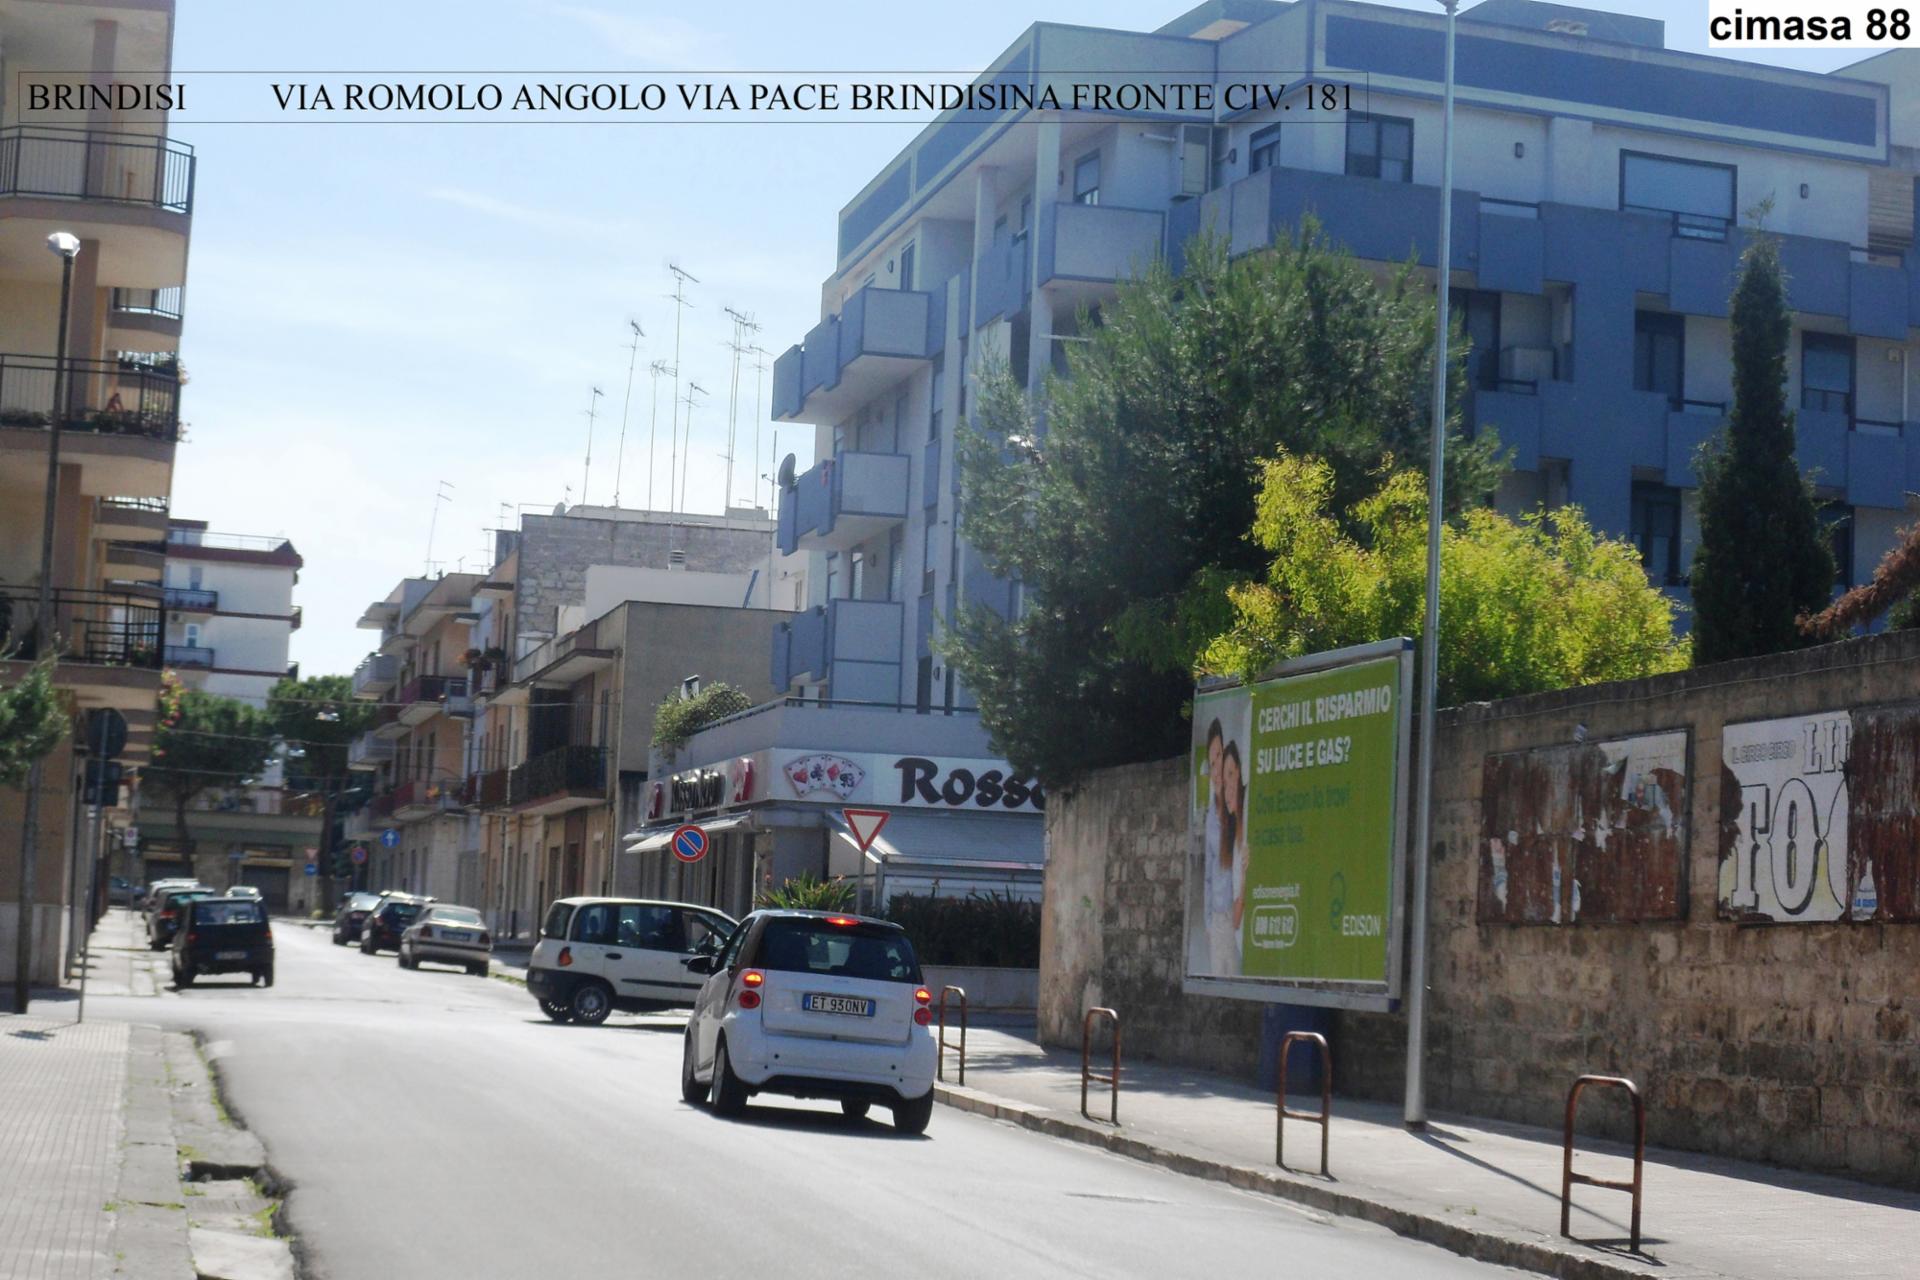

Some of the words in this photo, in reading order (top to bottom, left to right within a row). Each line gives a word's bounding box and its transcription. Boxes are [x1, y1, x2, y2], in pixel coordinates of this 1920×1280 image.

[1259, 702, 1300, 734] CERCHI
[1302, 700, 1313, 726] IL
[1315, 685, 1392, 723] RISPARMIO
[1256, 748, 1273, 774] SU
[1274, 743, 1303, 772] LUCE
[1305, 741, 1314, 767] E
[1316, 735, 1351, 766] GAS?
[1341, 914, 1381, 936] EDISON
[812, 996, 826, 1009] ET
